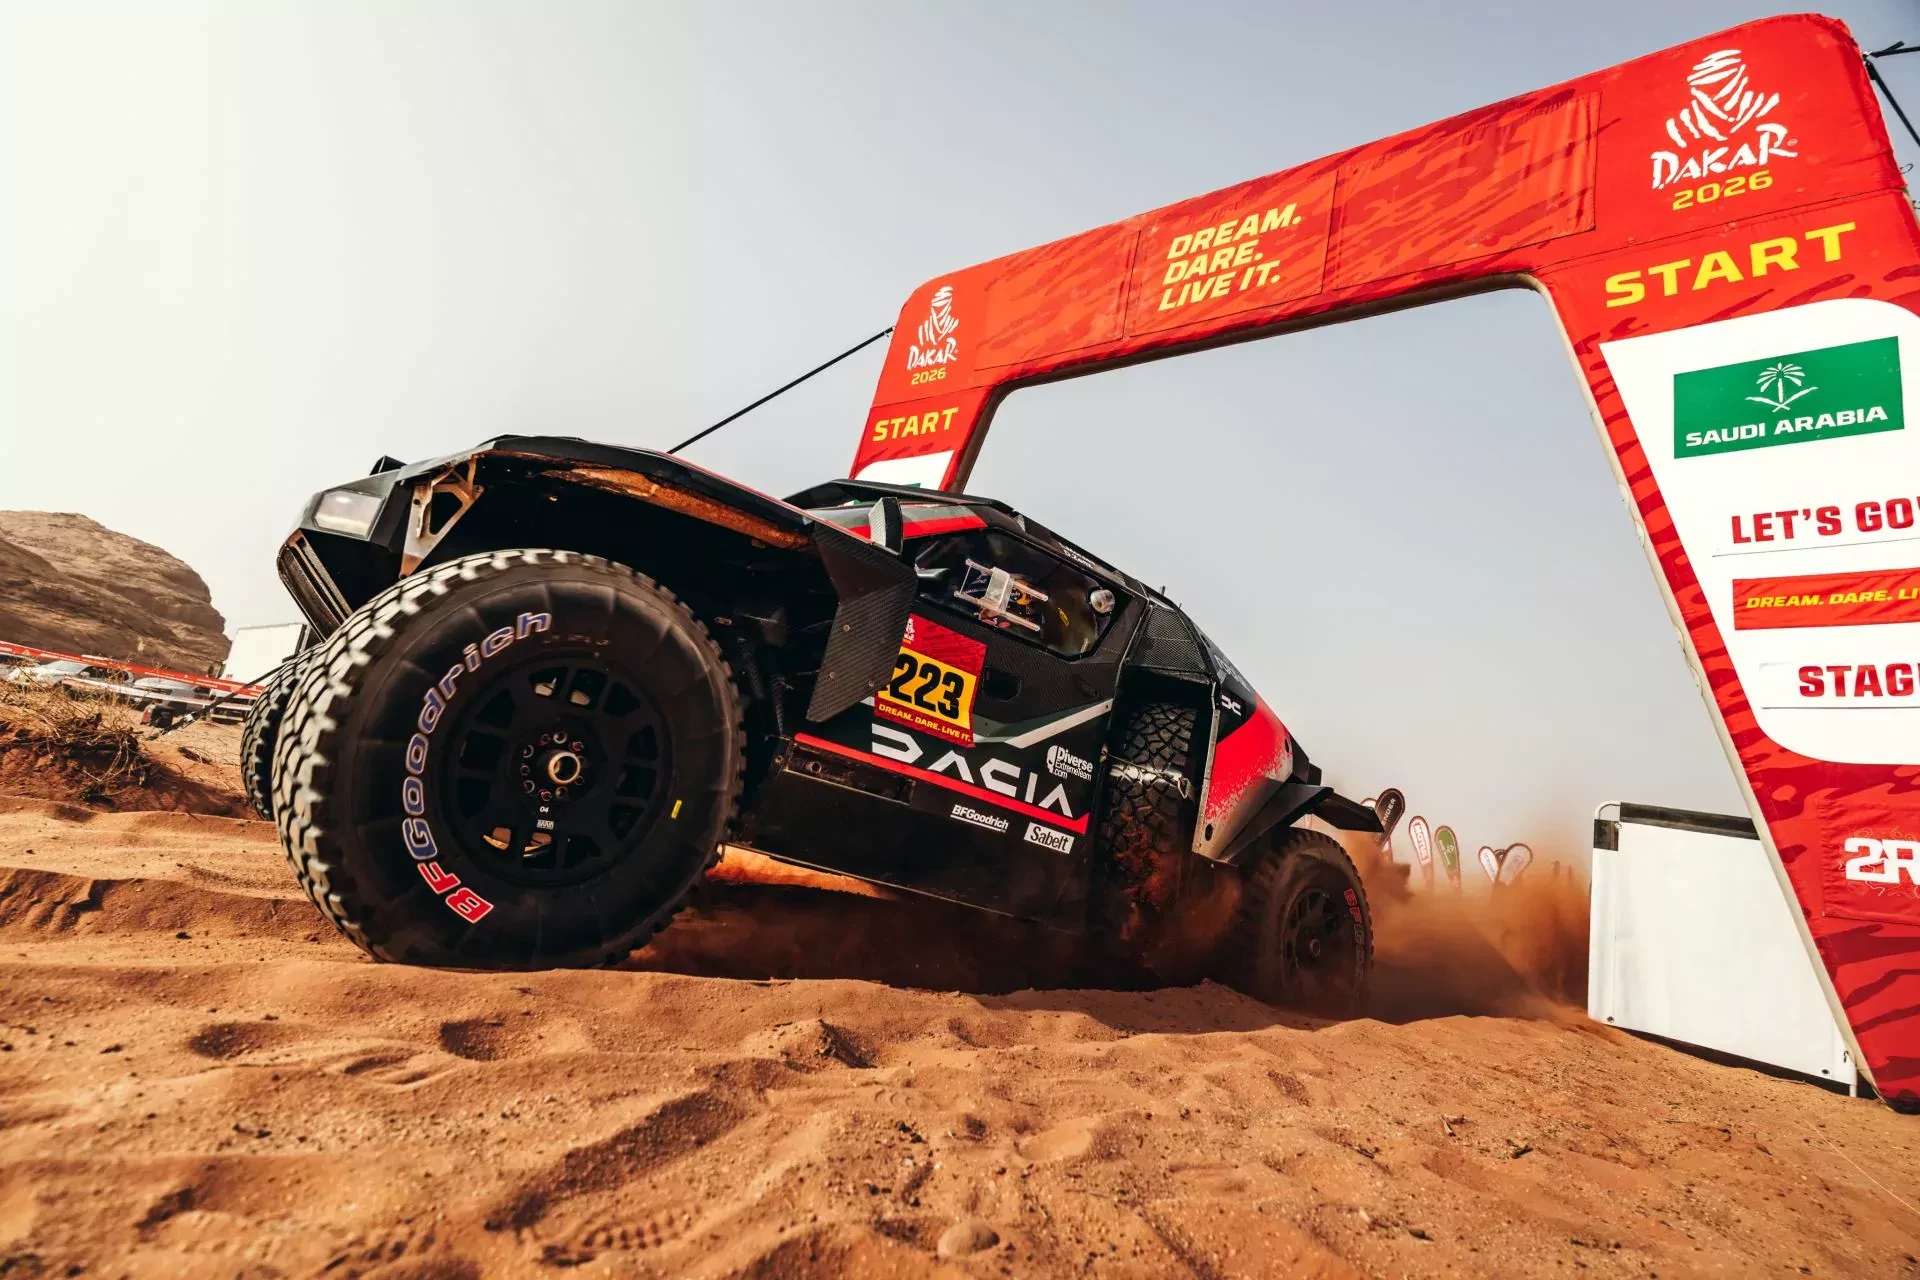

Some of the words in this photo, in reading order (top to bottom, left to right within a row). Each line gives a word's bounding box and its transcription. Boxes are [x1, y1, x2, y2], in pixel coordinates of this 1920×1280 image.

[1650, 122, 1798, 189] DAKAR
[1672, 170, 1774, 211] 2026
[1166, 202, 1302, 260] DREAM.
[1162, 239, 1264, 286] DARE.
[1604, 222, 1857, 308] START
[1157, 271, 1237, 312] LIVE
[1239, 260, 1281, 291] IT.
[906, 337, 958, 371] DAKAR
[911, 367, 947, 385] 2026
[872, 407, 959, 442] START
[1685, 423, 1766, 447] SAUDI
[1774, 405, 1889, 435] ARABIA
[1731, 505, 1843, 544] LET'S
[1855, 495, 1920, 533] GO
[1746, 594, 1824, 609] DREAM.
[1829, 589, 1892, 605] DARE.
[889, 653, 965, 720] 223
[1798, 662, 1920, 698] STAG
[878, 703, 914, 722] DREAM.
[914, 716, 941, 731] DARE.
[941, 725, 961, 738] LIVE
[961, 733, 971, 742] IT.
[402, 612, 552, 924] BFGoodrich
[872, 723, 1073, 818] DACIA
[1053, 768, 1068, 780] .com
[1055, 759, 1092, 781] ExtremeTeam
[1056, 746, 1093, 773] Diverse
[952, 804, 1010, 830] BFGoodrich
[1030, 825, 1069, 851] Sabelt
